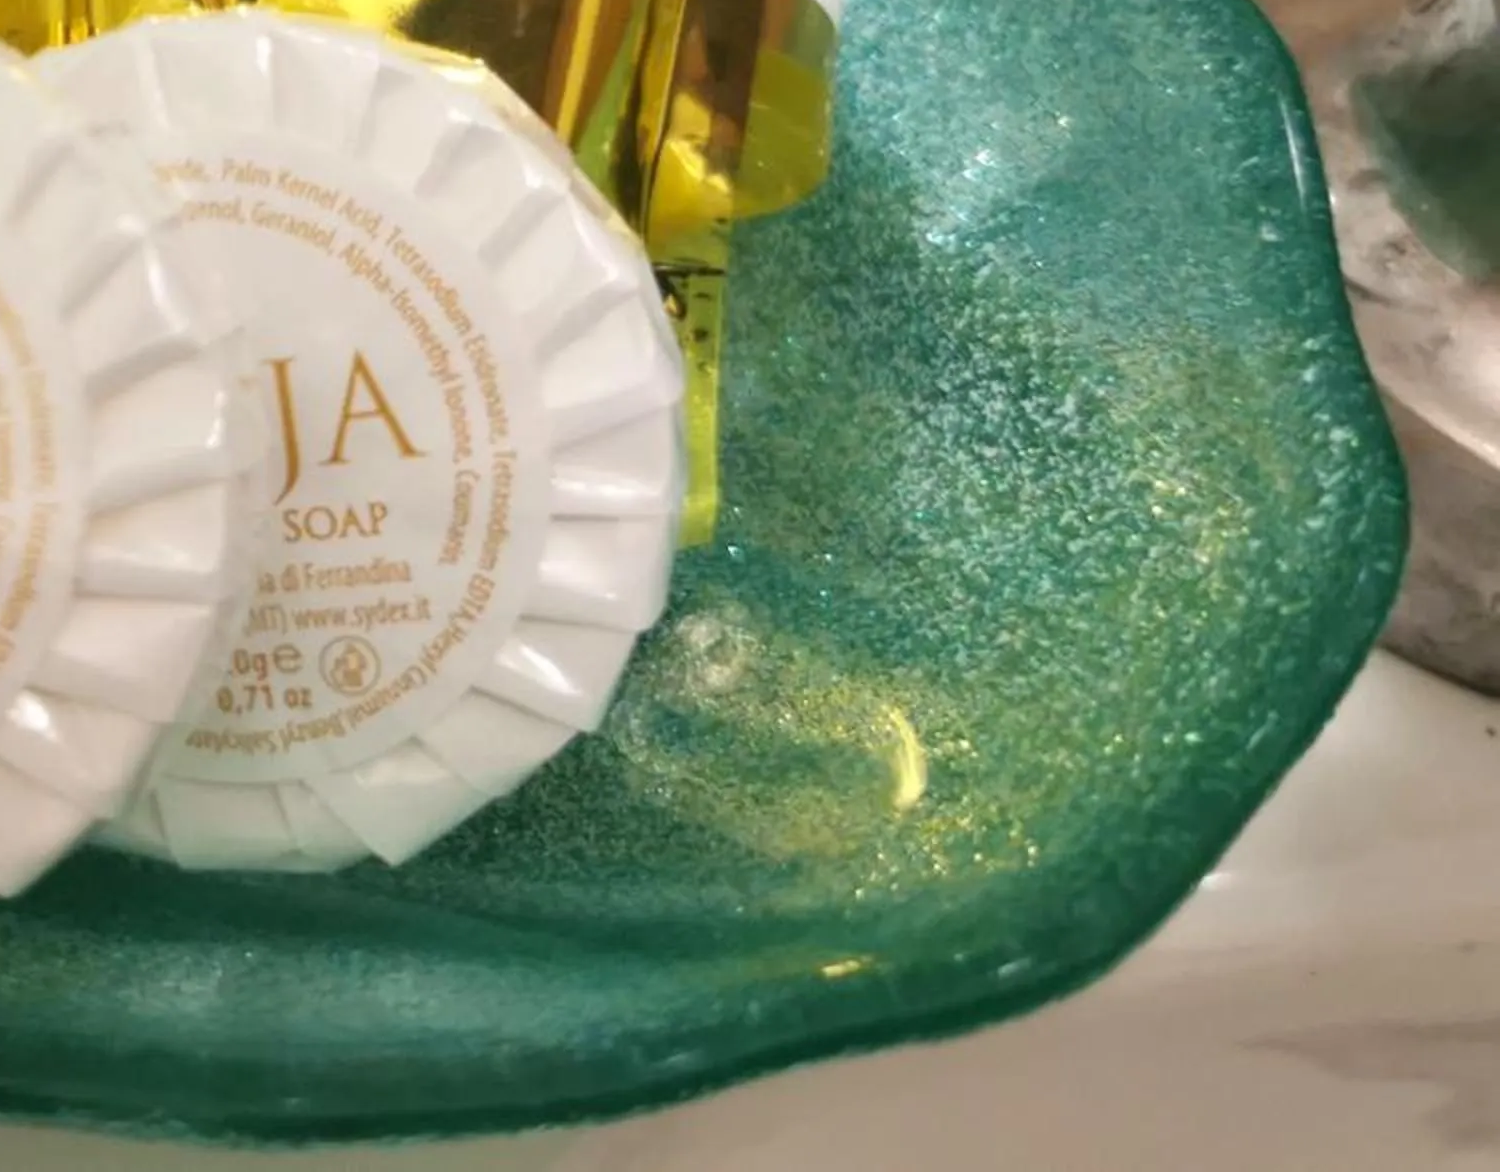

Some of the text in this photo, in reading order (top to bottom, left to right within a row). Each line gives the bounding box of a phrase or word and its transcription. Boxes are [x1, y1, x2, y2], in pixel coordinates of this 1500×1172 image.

[222, 158, 271, 186] Palm
[277, 169, 339, 209] Kernel
[386, 224, 472, 334] Tetrasodium
[261, 348, 428, 506] JA
[282, 501, 389, 544] SOAP
[217, 684, 313, 715] 0,71 oz
